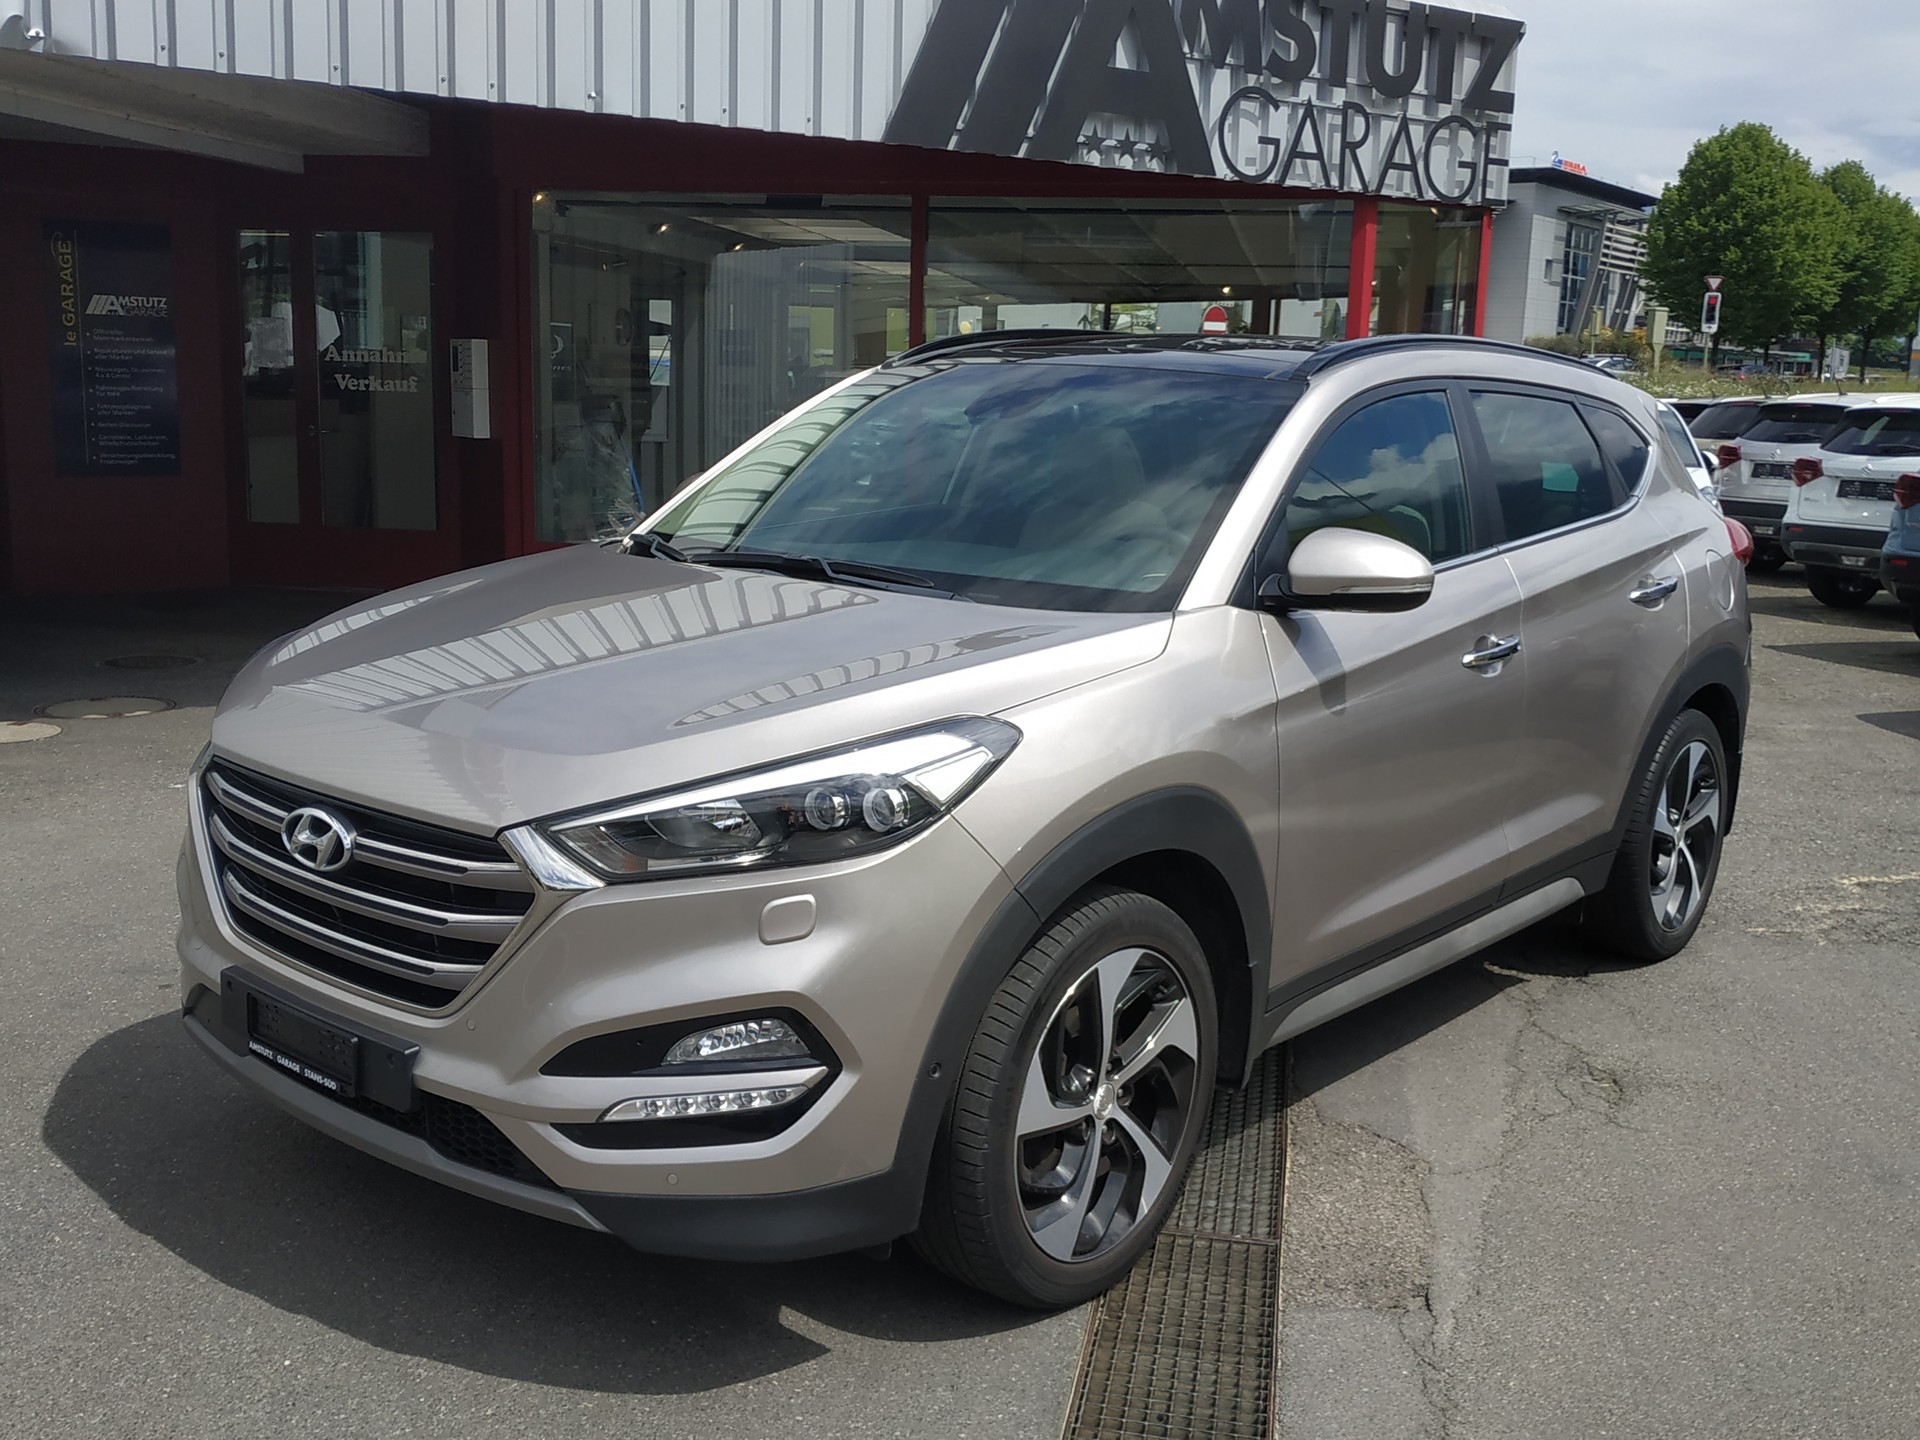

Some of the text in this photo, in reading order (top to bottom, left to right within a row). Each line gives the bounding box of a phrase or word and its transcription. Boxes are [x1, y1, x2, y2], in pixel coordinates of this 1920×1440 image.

[1022, 0, 1526, 176] AMSTUTZ
[1218, 86, 1512, 202] GARAGE
[58, 240, 77, 345] le GARAGE
[99, 294, 167, 316] AMSTUTZ
[124, 306, 169, 319] GARAGE
[334, 374, 418, 392] Verkauf
[249, 1040, 273, 1059] AMSTUTZ
[277, 1055, 300, 1073] GARAGE
